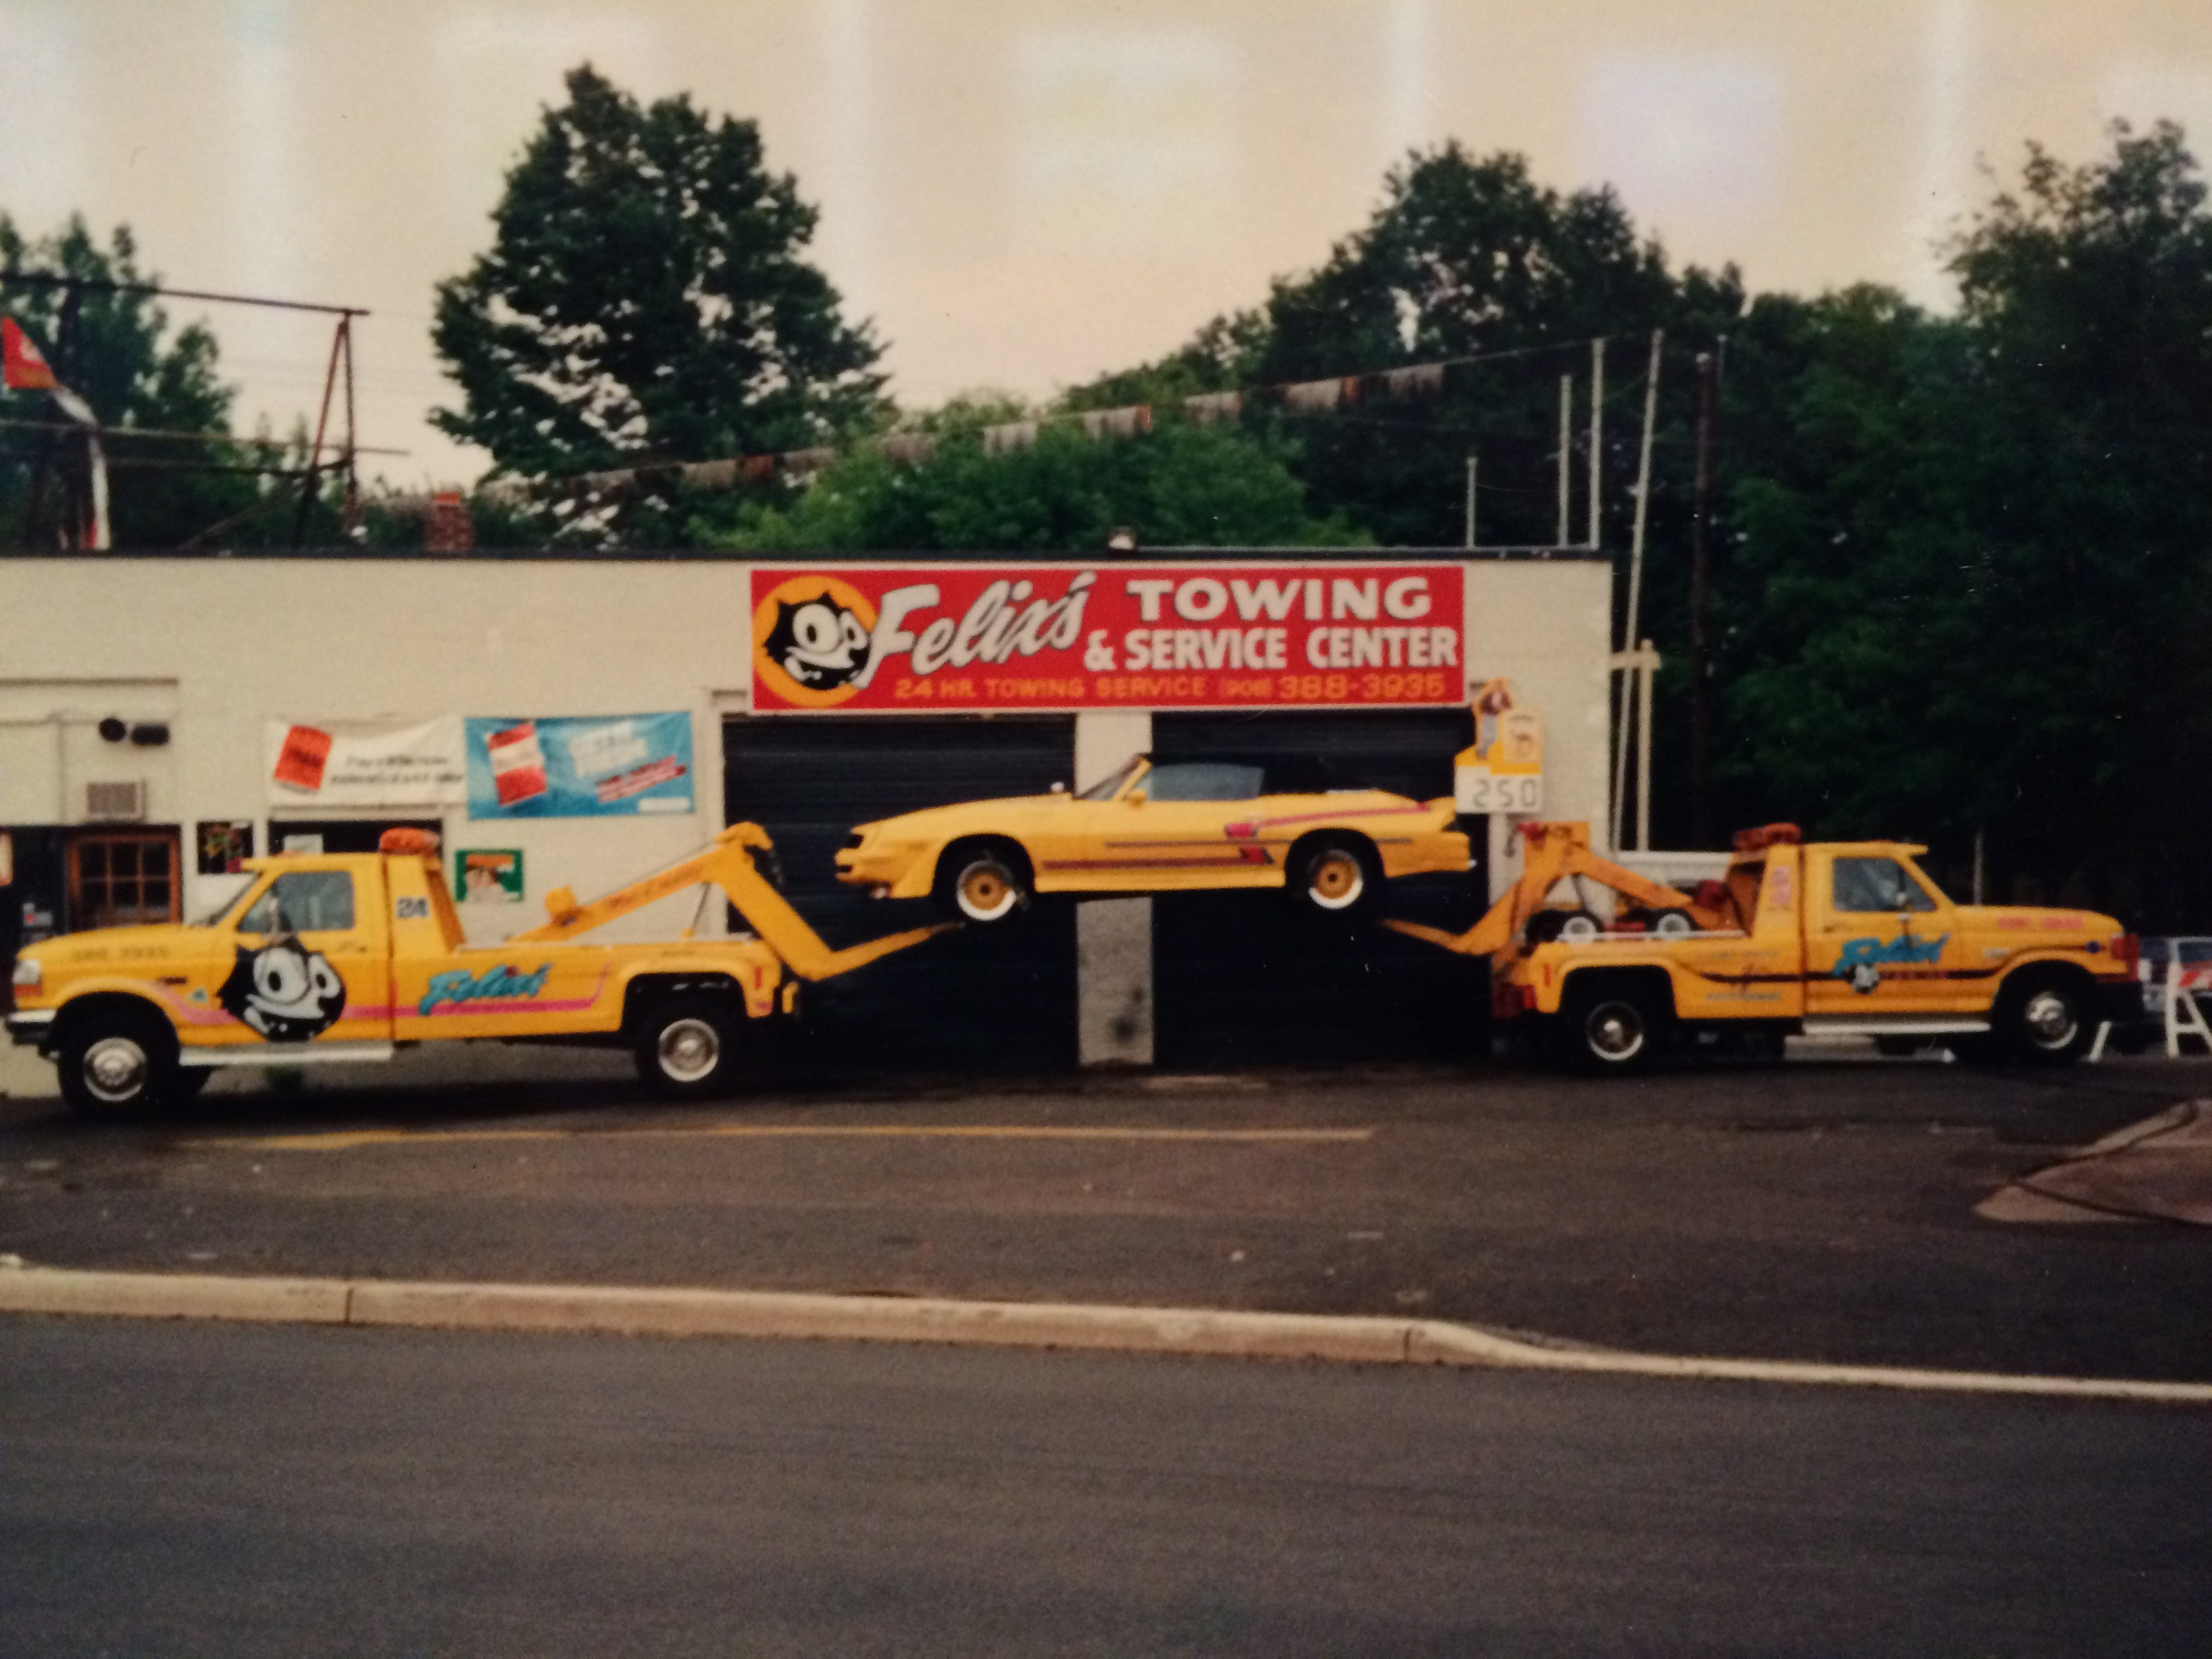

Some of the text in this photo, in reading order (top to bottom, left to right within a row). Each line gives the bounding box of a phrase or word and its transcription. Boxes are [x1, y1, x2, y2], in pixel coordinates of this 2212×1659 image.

[1126, 576, 1431, 621] TOWING
[852, 570, 1097, 689] Felix's
[1084, 626, 1457, 671] & SERVICE CENTER
[895, 678, 932, 699] 24
[985, 678, 1084, 698] TOWING
[1096, 678, 1206, 699] SERVICE
